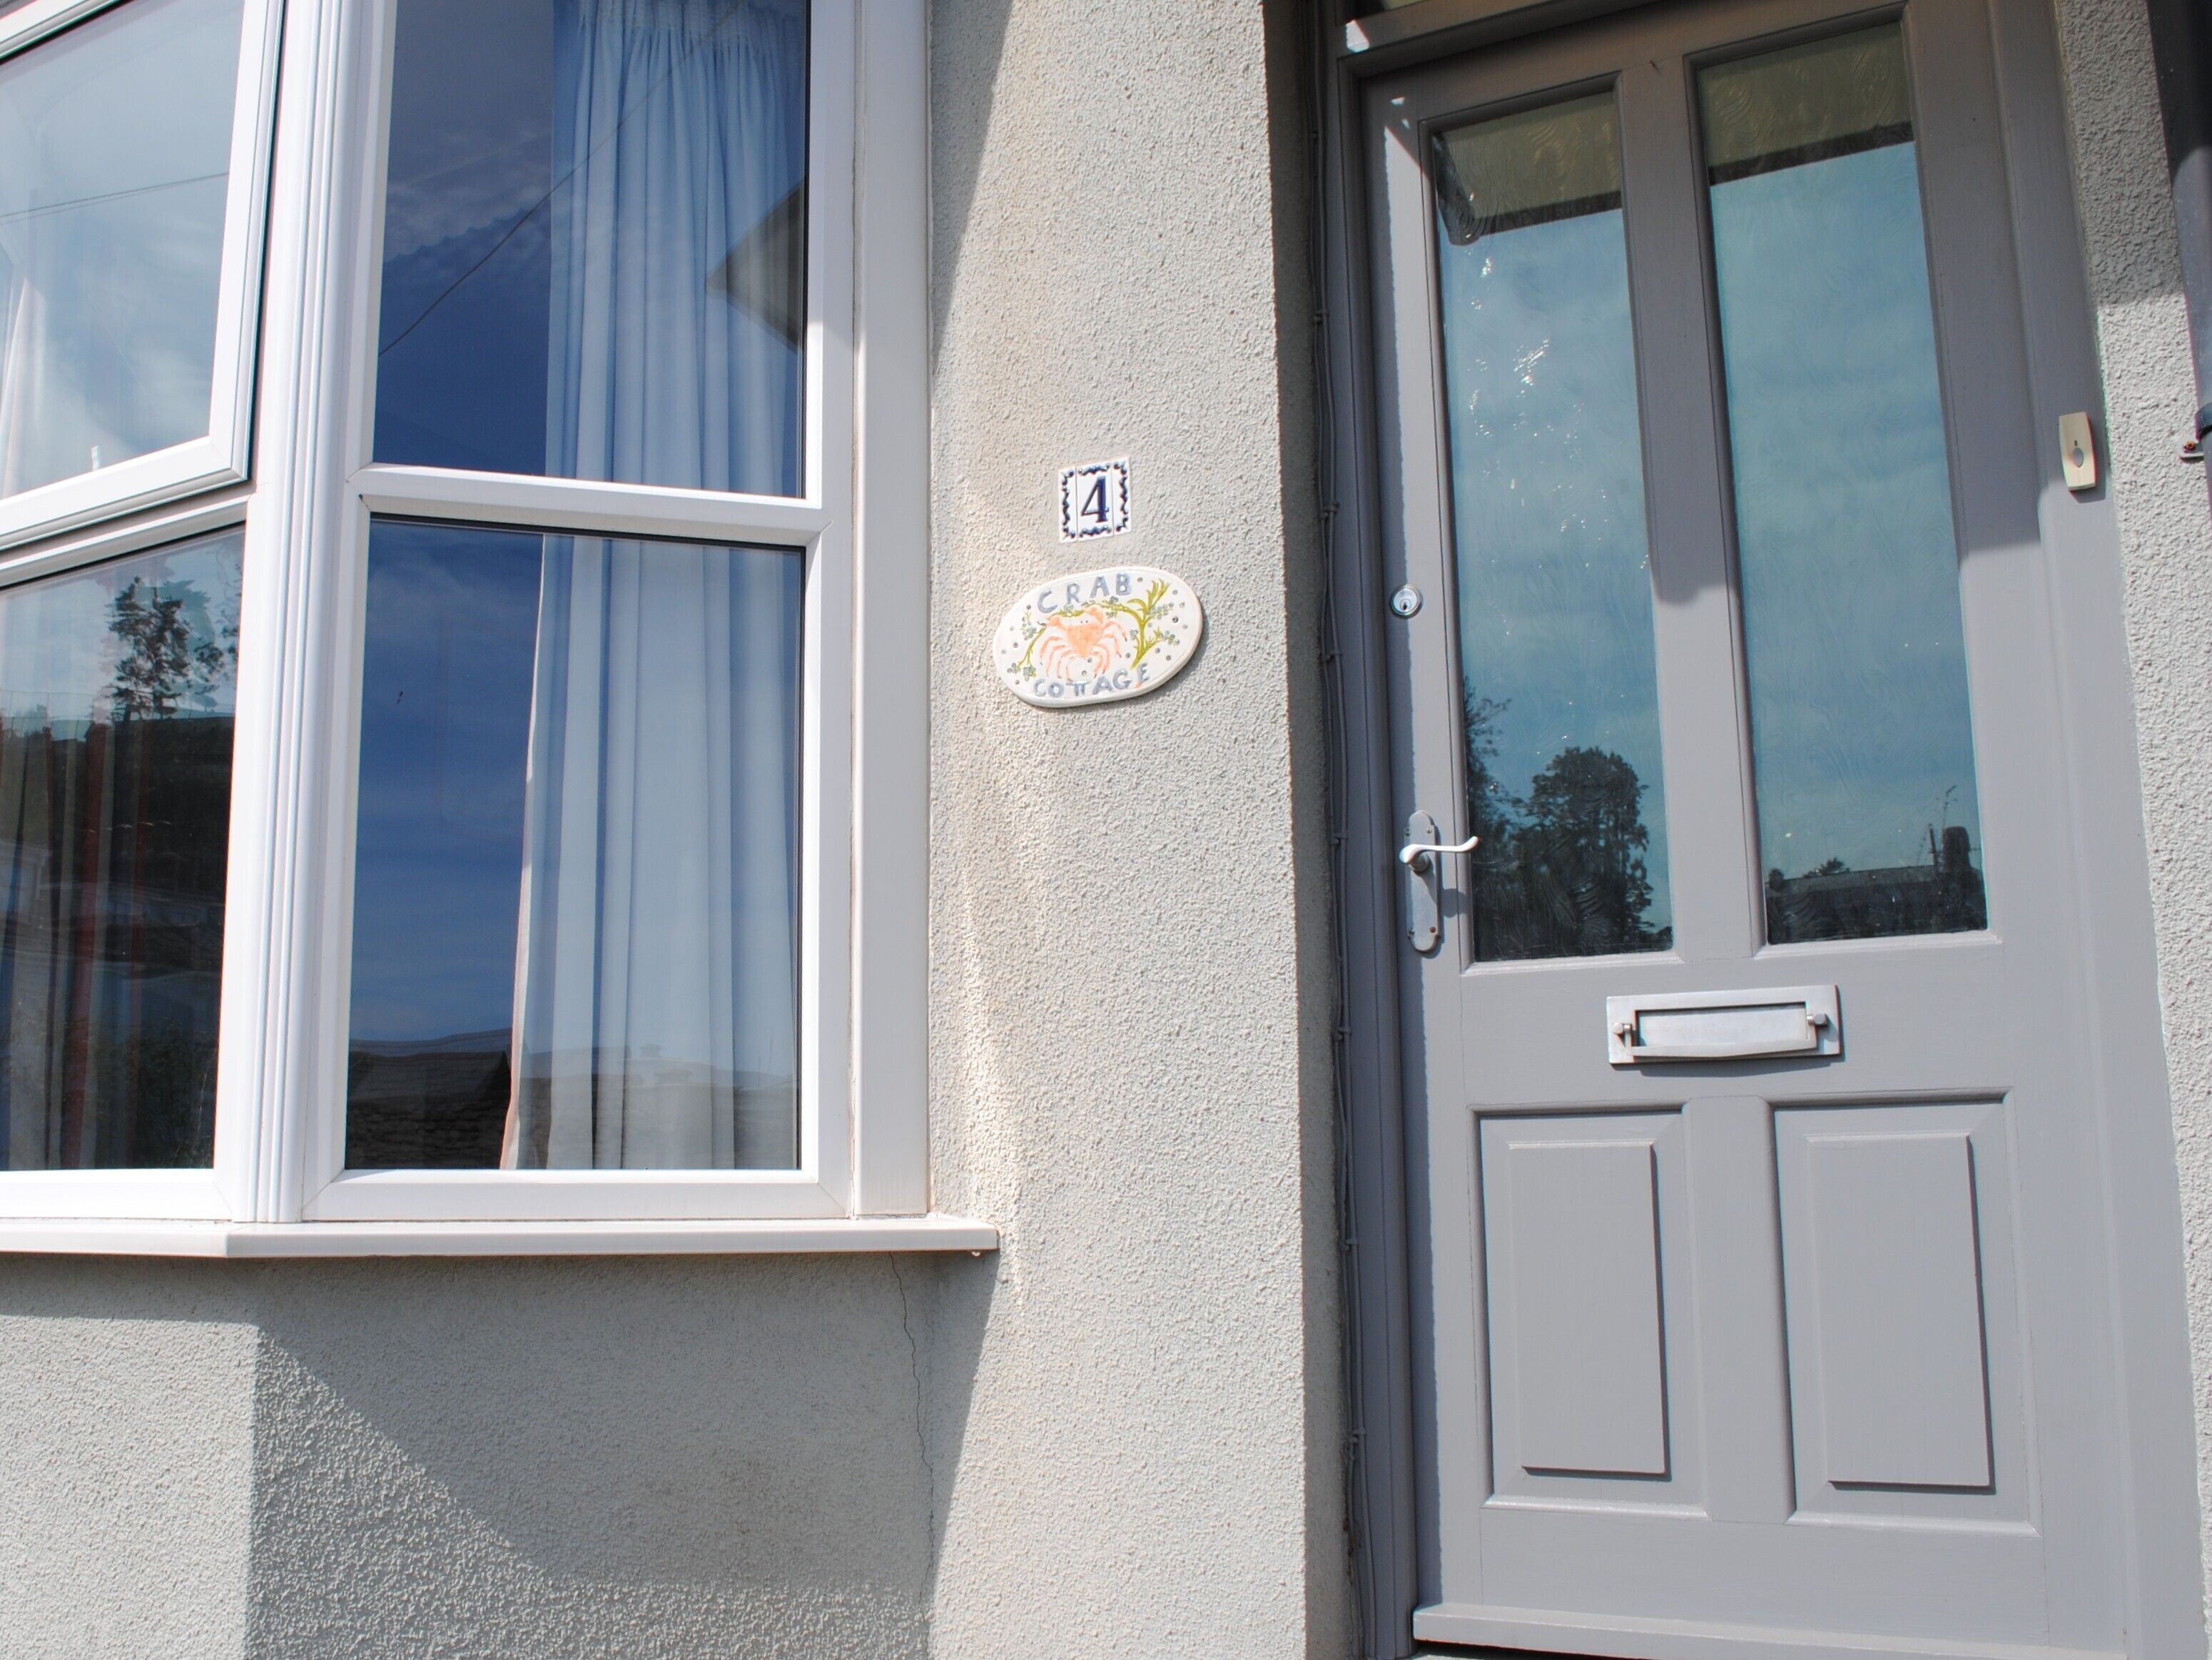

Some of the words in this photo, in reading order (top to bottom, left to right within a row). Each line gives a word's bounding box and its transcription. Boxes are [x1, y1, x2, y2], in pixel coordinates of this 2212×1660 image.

[1080, 475, 1110, 523] 4
[1037, 573, 1132, 614] CRAB
[1033, 663, 1150, 697] COTTAGE
